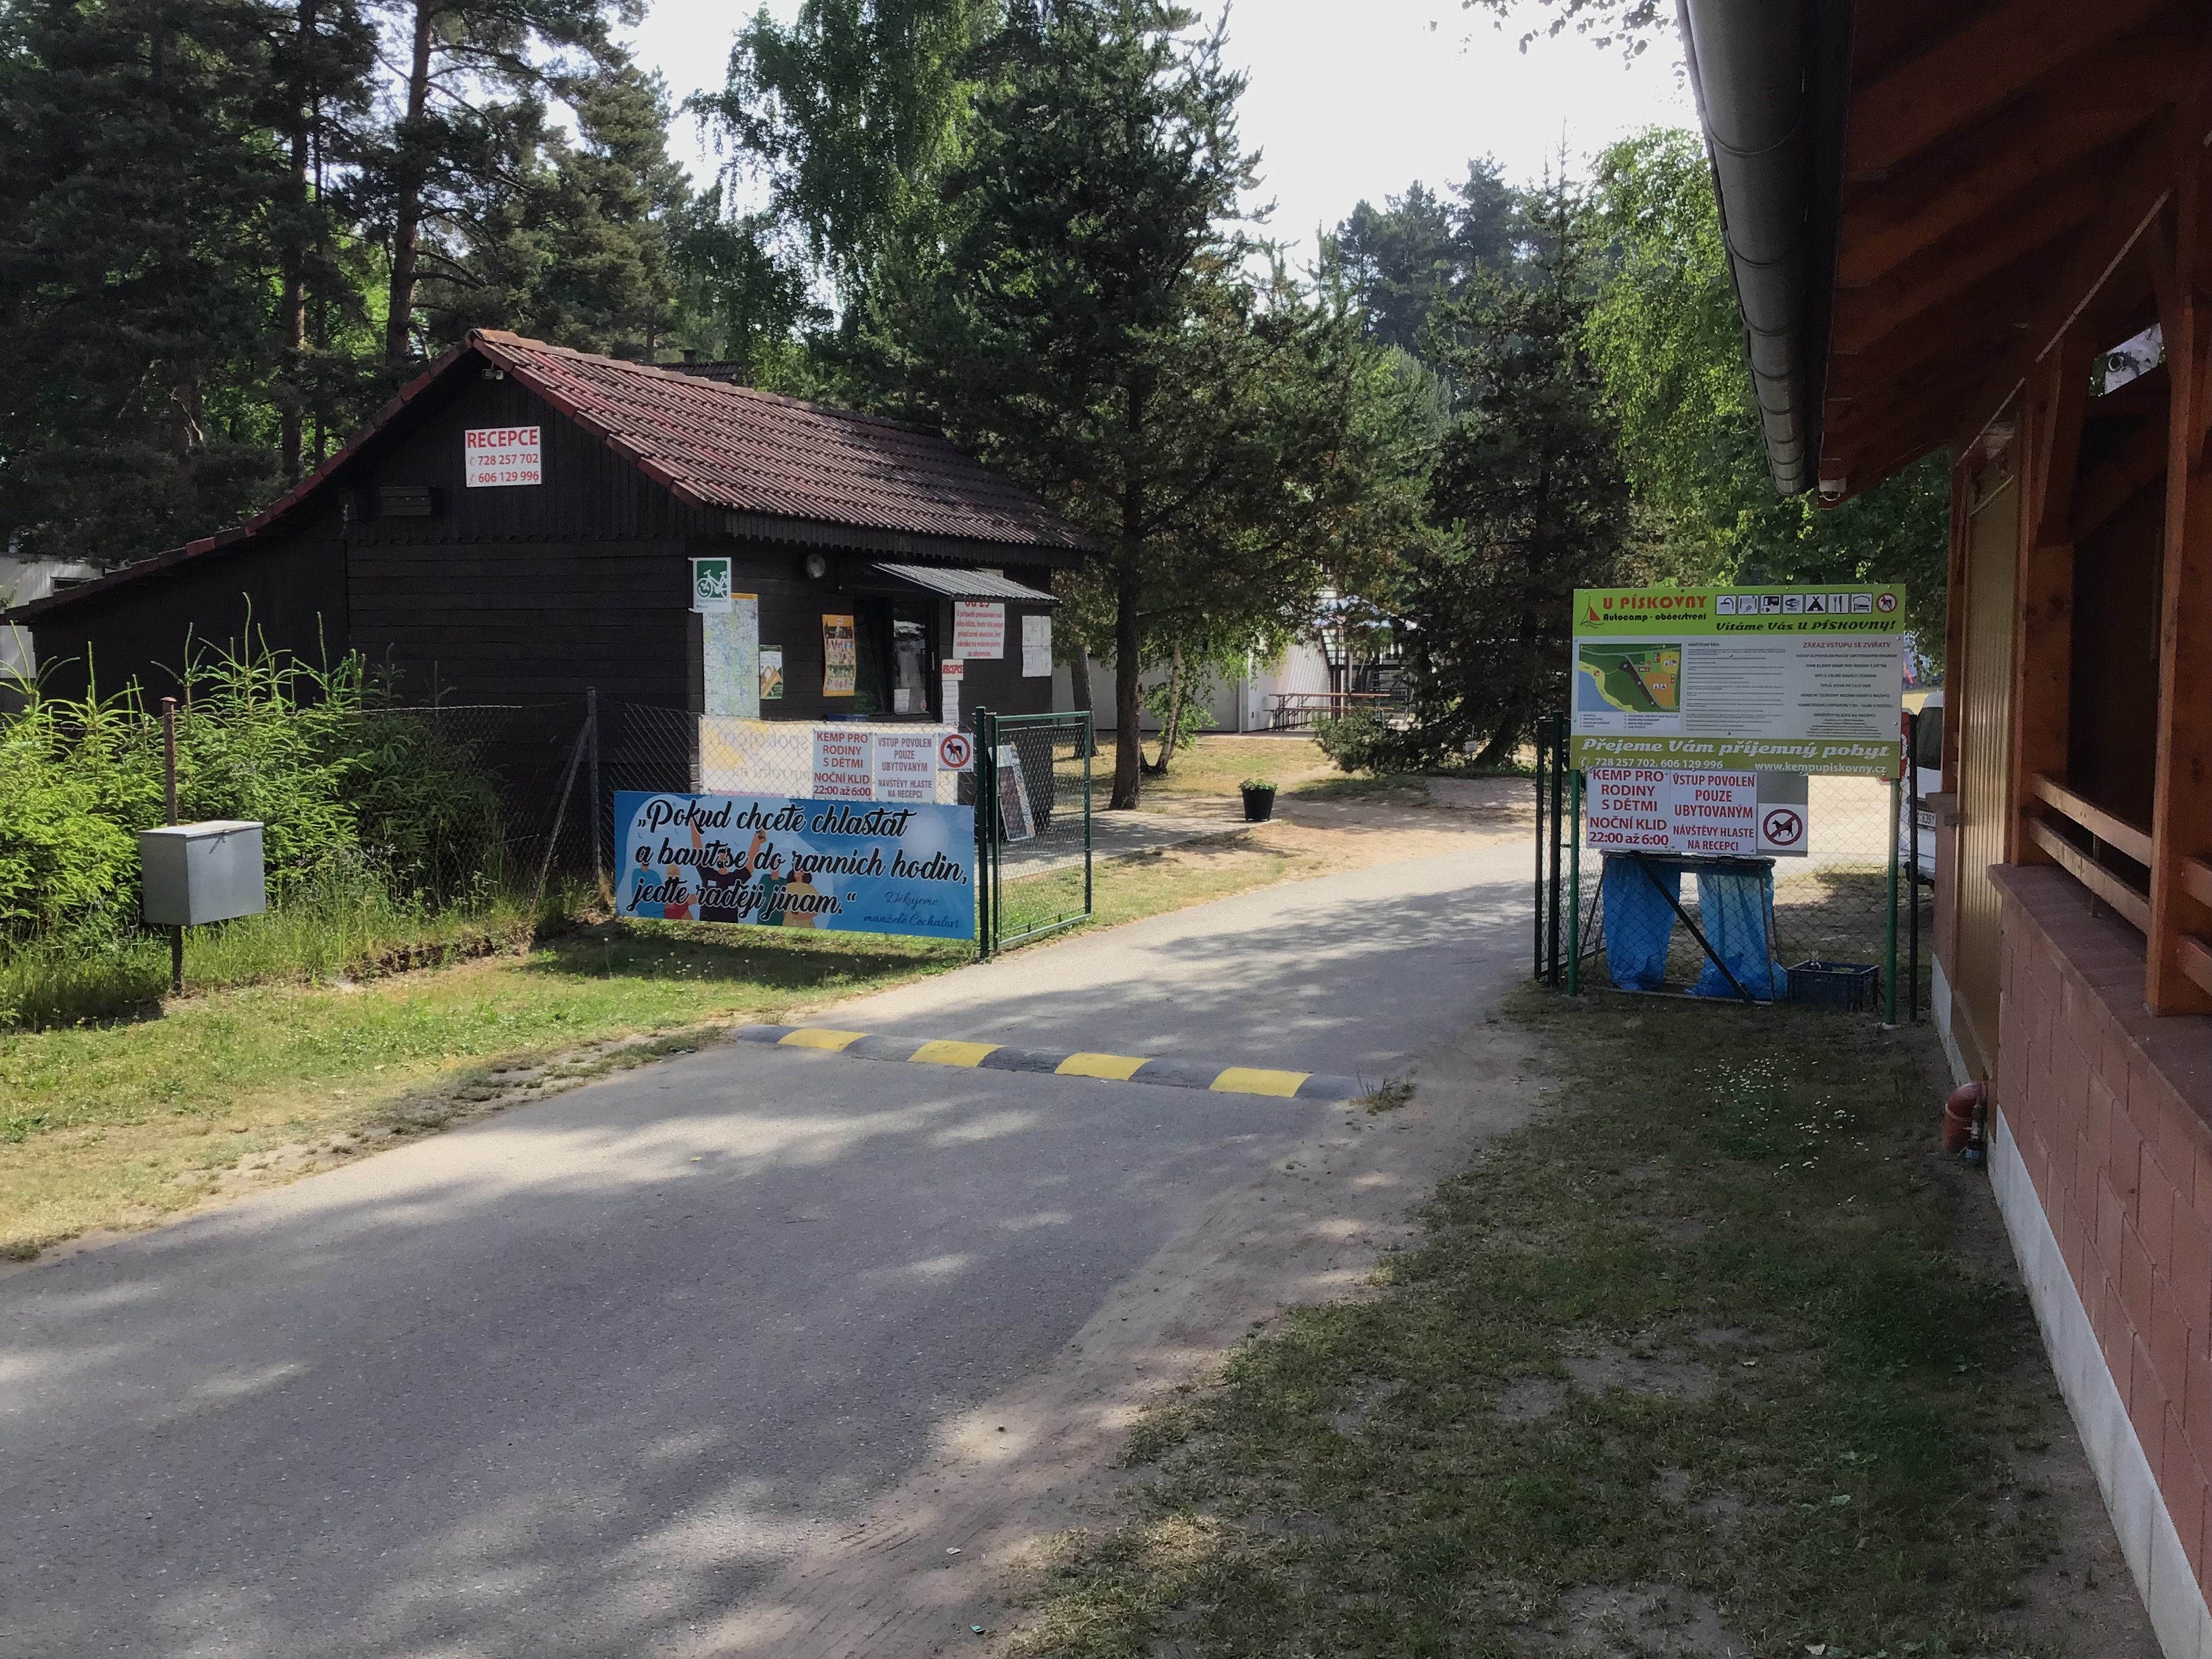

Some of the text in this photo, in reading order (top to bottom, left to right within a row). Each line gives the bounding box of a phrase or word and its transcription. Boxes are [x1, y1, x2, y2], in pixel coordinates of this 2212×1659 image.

[467, 428, 538, 448] RECEPCE
[478, 453, 539, 466] 728 257 702
[478, 471, 539, 483] 606 129 996
[1603, 594, 1707, 609] U PÍSKOVNY
[1603, 613, 1648, 622] Autocamp
[1715, 621, 1764, 631] Vítáme
[1767, 621, 1794, 630] Vás
[1797, 621, 1808, 630] U
[943, 665, 964, 674] RECEPCE
[817, 733, 868, 743] KEMP PRO
[878, 737, 932, 747] VSTUP POVOLEN
[823, 745, 862, 756] RODINY
[894, 750, 915, 759] POUZE
[1581, 737, 1889, 760] Přejeme Vám příjemný pobyt
[823, 756, 863, 769] S DĚTMI
[882, 760, 928, 772] UBYTOVANÝM
[1595, 758, 1723, 769] 728 257 702, 606 129 996
[1755, 762, 1887, 774] www.kempupiskovny.cz
[814, 770, 846, 783] NOČNÍ
[848, 775, 870, 784] KLID
[1593, 769, 1664, 782] KEMP PRO
[1673, 775, 1755, 787] VSTUP POVOLEN
[909, 780, 933, 788] HLASTE
[1601, 784, 1655, 796] RODINY
[813, 785, 872, 797] 22:00 až 6:00
[887, 790, 922, 798] NA RECEPCI
[1696, 790, 1732, 802] POUZE
[1601, 798, 1658, 812] S DĚTMI
[1675, 804, 1753, 819] UBYTOVANÝM
[736, 802, 806, 832] chcete
[811, 805, 917, 837] chlastat
[1590, 815, 1667, 830] NOČNÍ KLID
[1673, 823, 1754, 838] NÁVŠTĚVY HLASTE
[1589, 832, 1669, 846] 22:00 až 6:00
[1688, 840, 1739, 851] NA RECEPCI
[635, 845, 654, 864] a
[657, 837, 728, 867] bavit
[724, 848, 748, 869] se
[754, 842, 785, 870] do
[890, 849, 967, 884] hodin,
[695, 879, 765, 919] raději
